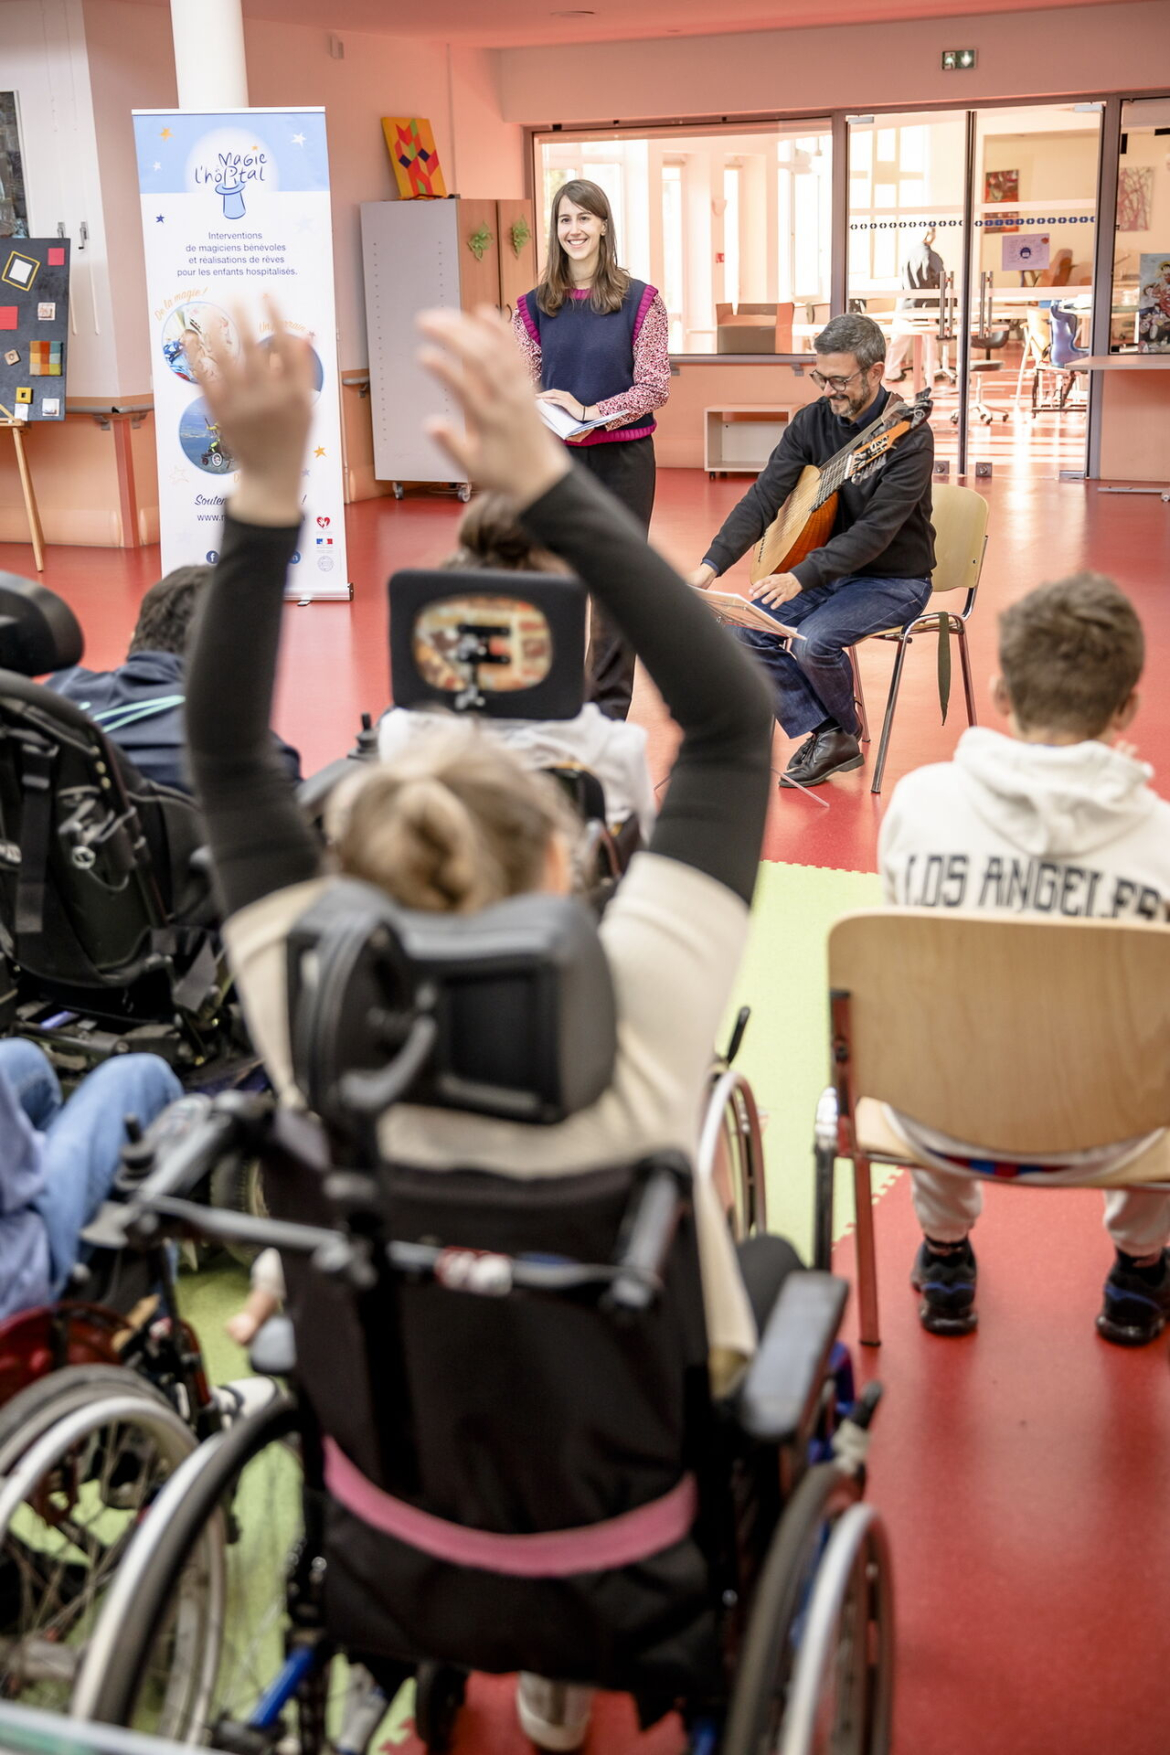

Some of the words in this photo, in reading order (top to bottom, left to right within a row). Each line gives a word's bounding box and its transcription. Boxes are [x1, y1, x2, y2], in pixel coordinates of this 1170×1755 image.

[208, 231, 263, 240] Interventions
[185, 244, 197, 252] de
[199, 244, 241, 254] magiciens
[244, 243, 286, 252] bénévoles
[199, 256, 247, 264] réalisations
[249, 255, 260, 264] de
[262, 255, 285, 263] rêves
[177, 269, 196, 277] pour
[198, 268, 211, 276] les
[213, 268, 244, 276] enfants
